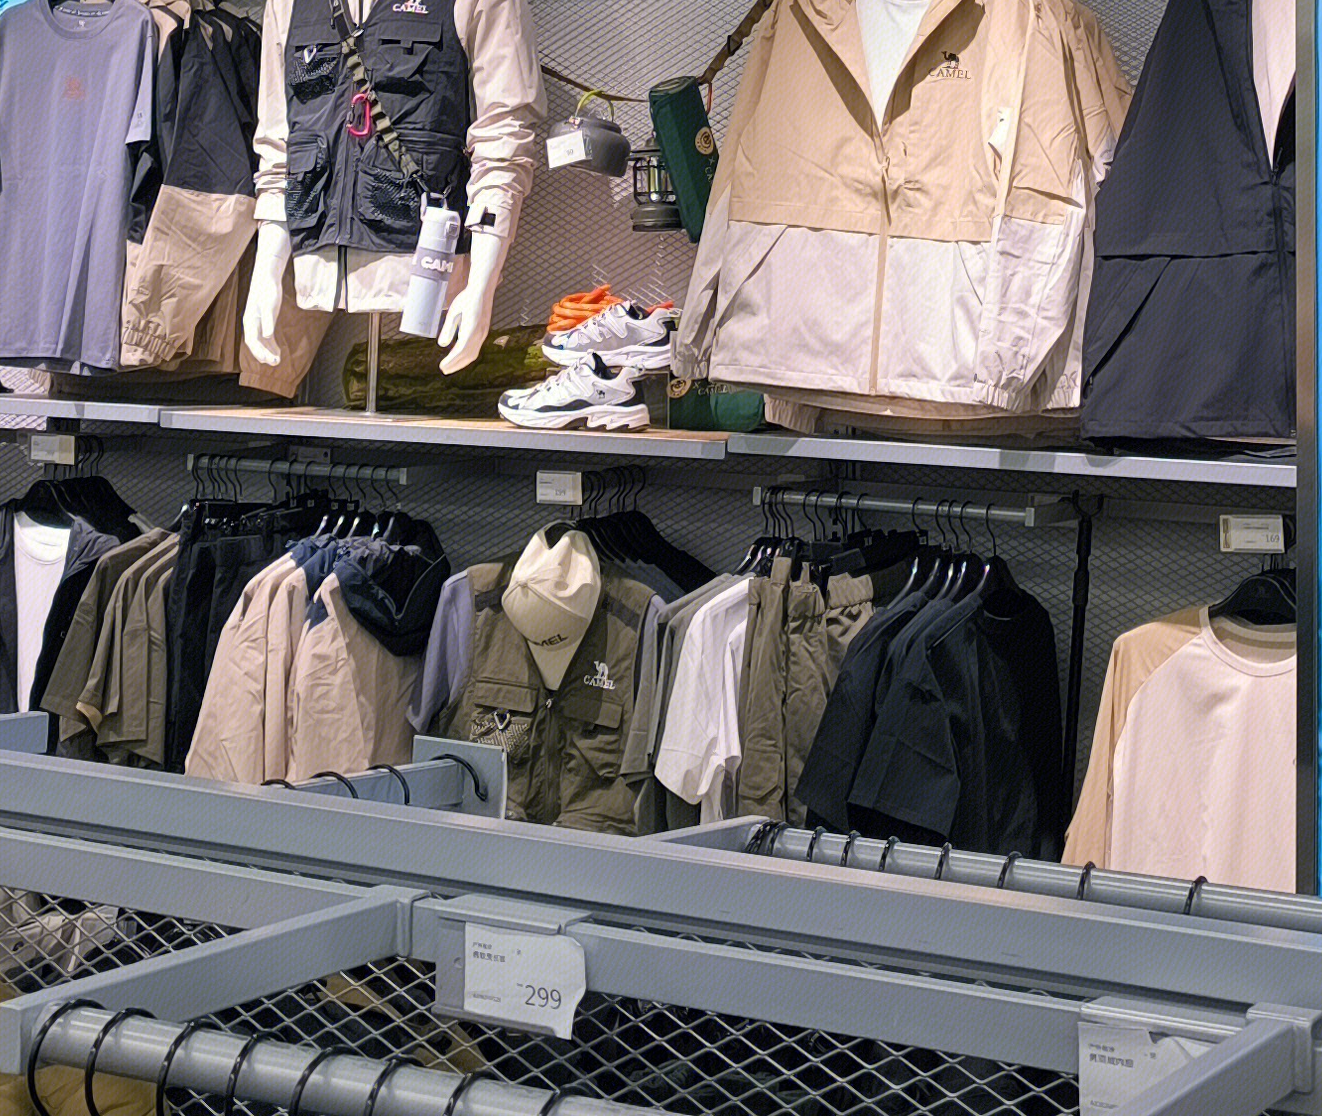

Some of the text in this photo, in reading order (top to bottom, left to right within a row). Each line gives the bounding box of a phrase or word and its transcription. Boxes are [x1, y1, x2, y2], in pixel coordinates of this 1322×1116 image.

[392, 3, 429, 14] CAMEL
[928, 67, 971, 80] CAMEL
[583, 674, 616, 690] CAMEL
[525, 984, 562, 1010] 299
